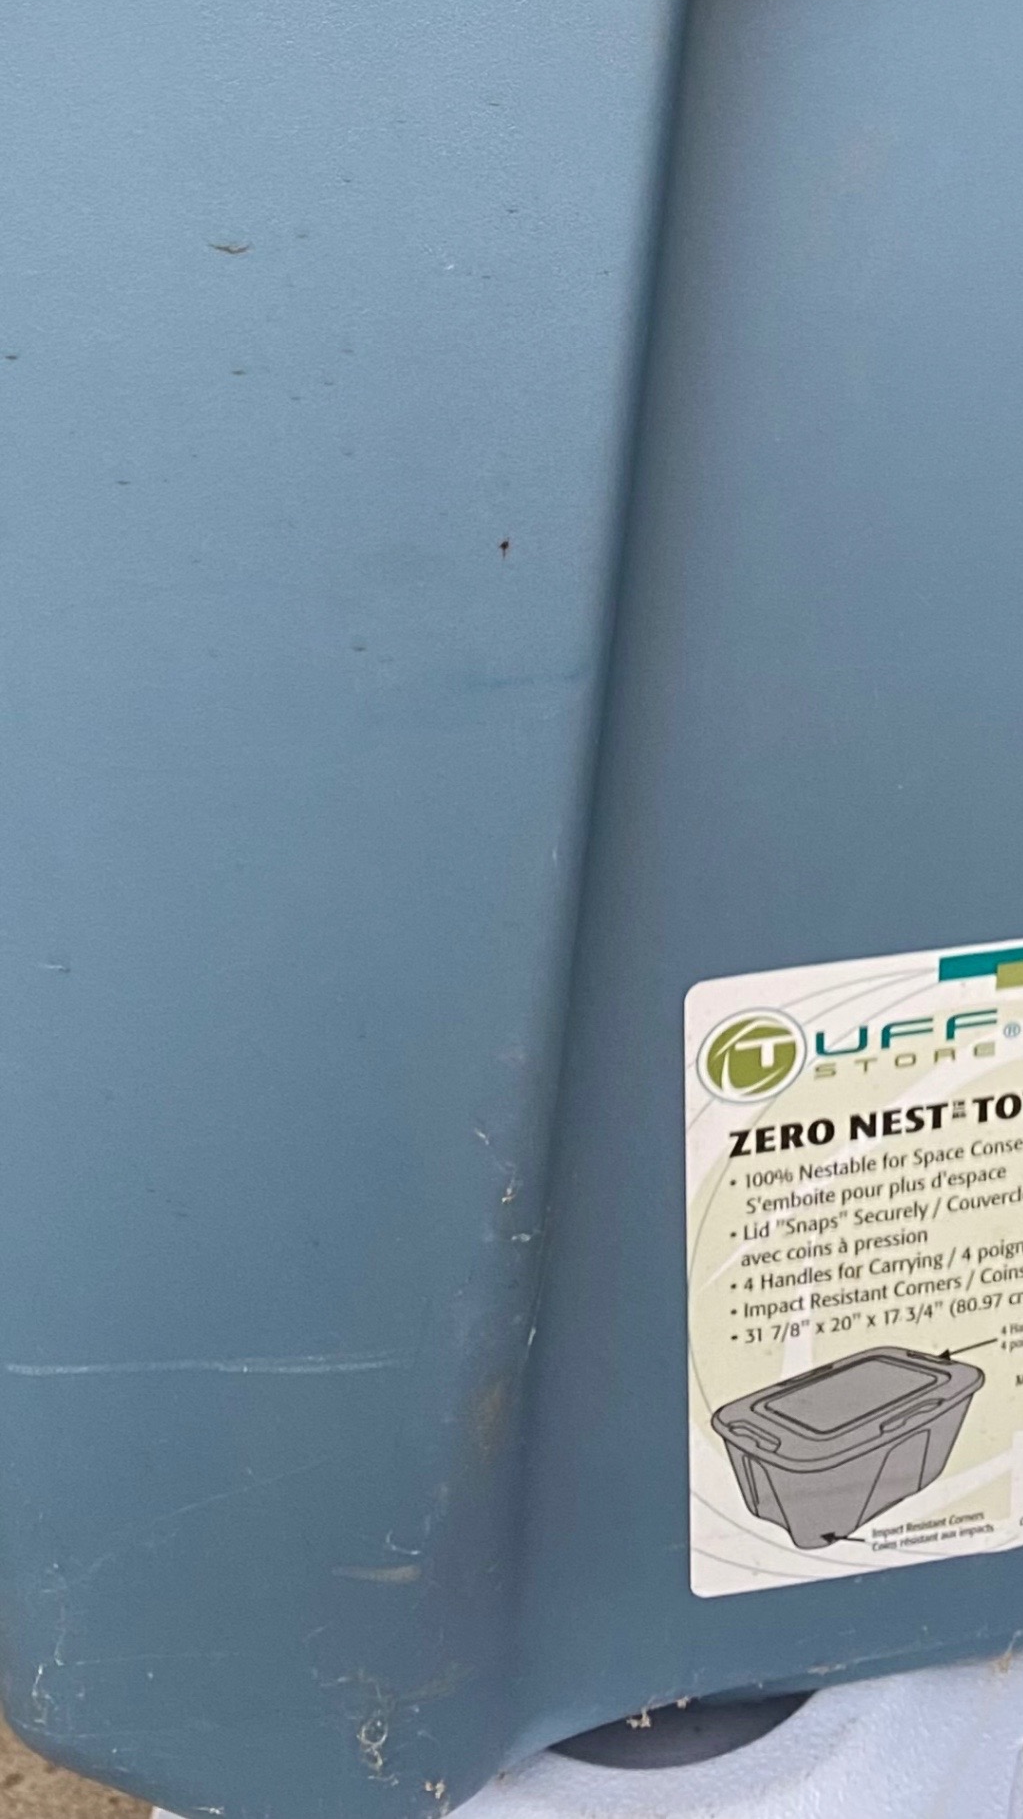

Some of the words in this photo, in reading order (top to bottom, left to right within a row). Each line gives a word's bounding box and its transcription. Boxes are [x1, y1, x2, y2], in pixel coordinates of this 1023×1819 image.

[814, 1042, 996, 1080] STORE
[729, 1118, 835, 1159] ZERO
[850, 1102, 949, 1141] NEST
[745, 1167, 794, 1189] 100%
[799, 1155, 877, 1180] Nestable
[883, 1153, 907, 1170] for
[913, 1145, 964, 1171] Space
[746, 1186, 836, 1215] S'emboite
[841, 1183, 883, 1205] pour
[889, 1175, 926, 1199] plus
[931, 1165, 1008, 1189] d'espace
[743, 1222, 770, 1241] Lid
[776, 1210, 848, 1237] "Snaps"
[853, 1199, 929, 1226] Securely
[741, 1248, 782, 1267] avec
[787, 1241, 832, 1261] coins
[838, 1236, 848, 1253] à
[854, 1228, 928, 1255] pression
[744, 1277, 753, 1291] 4
[761, 1267, 832, 1290] Handles
[839, 1262, 863, 1279] for
[869, 1252, 944, 1275] Carrying
[961, 1247, 971, 1261] 4
[744, 1297, 804, 1319] Impact
[810, 1284, 887, 1310] Resistant
[894, 1277, 962, 1297] Corners
[745, 1327, 762, 1344] 31
[772, 1319, 810, 1342] 7/8"
[816, 1322, 825, 1334] x
[831, 1313, 861, 1332] 20"
[867, 1315, 876, 1327] x
[906, 1301, 944, 1324] 3/4"
[950, 1293, 1003, 1318] (80.97
